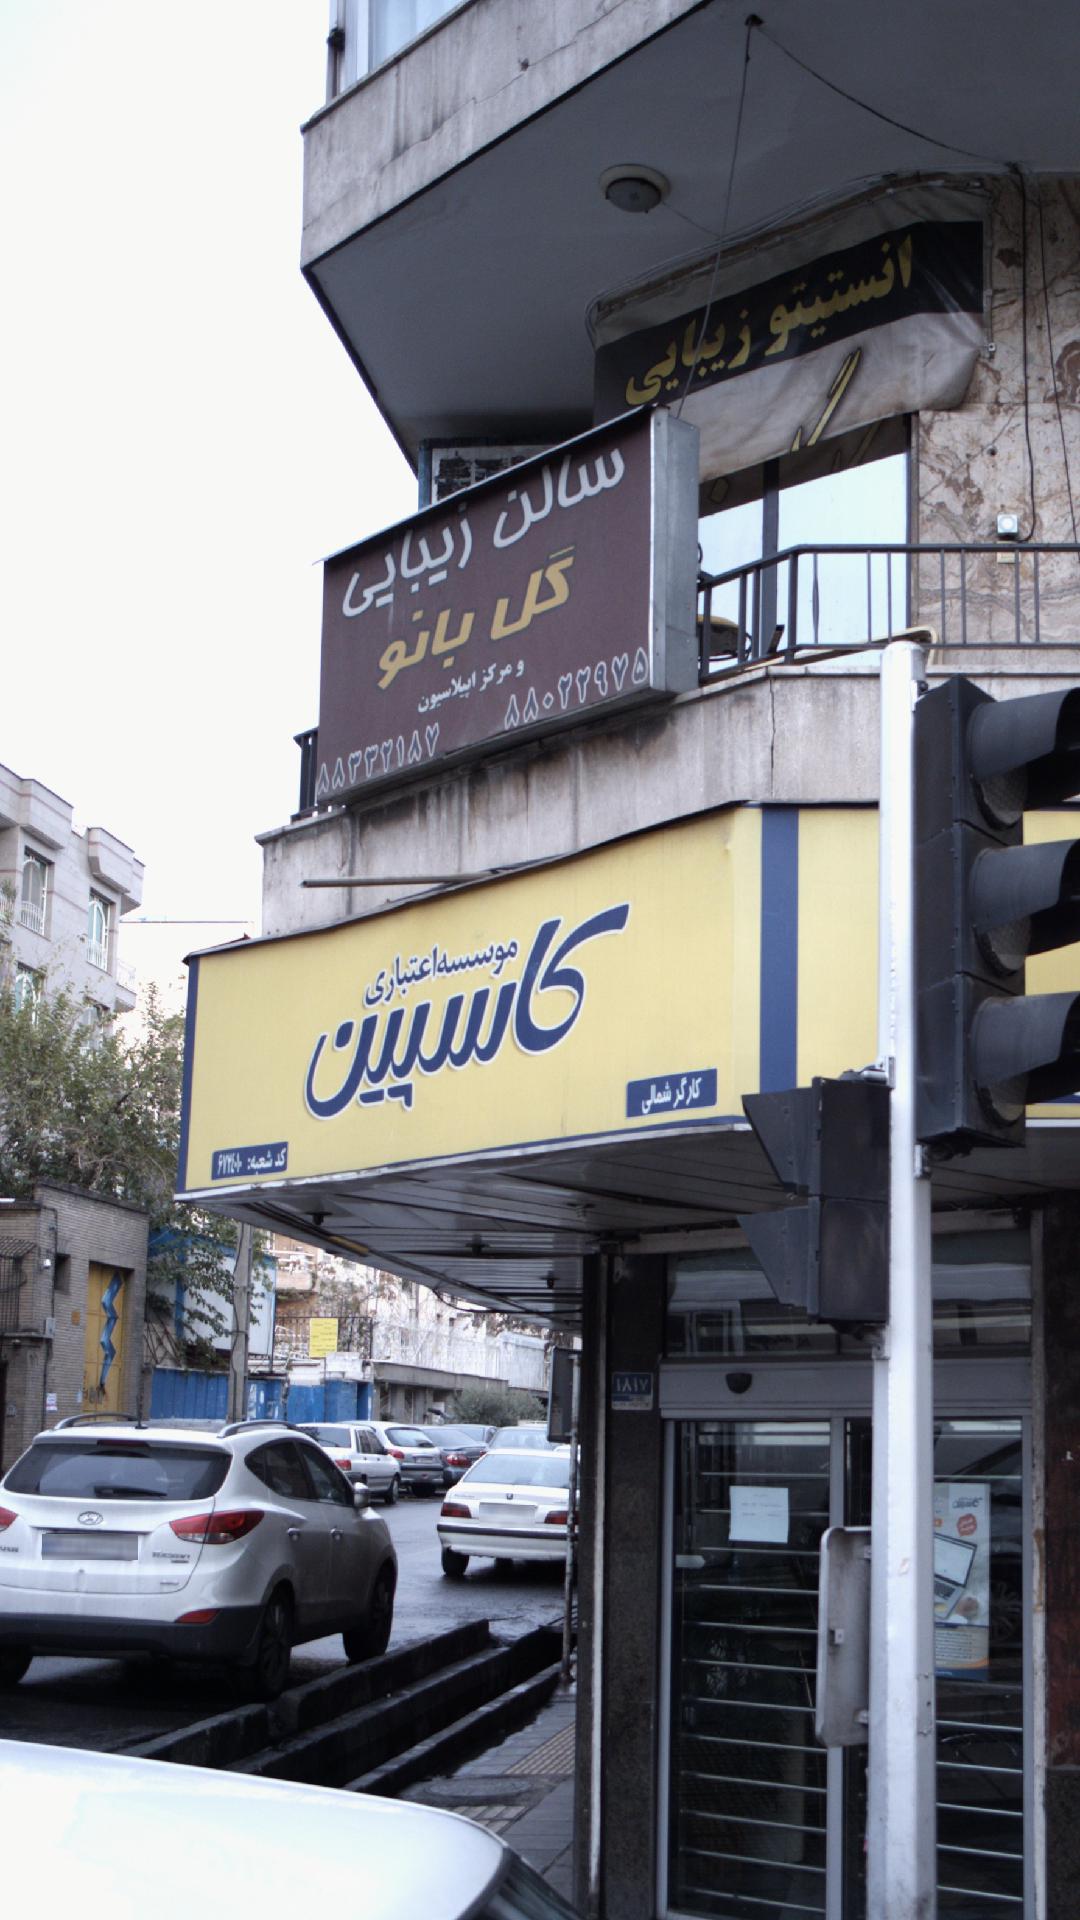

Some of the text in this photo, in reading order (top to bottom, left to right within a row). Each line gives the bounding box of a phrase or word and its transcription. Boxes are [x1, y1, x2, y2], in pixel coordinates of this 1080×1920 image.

[764, 234, 913, 356] انستیتو
[625, 307, 752, 405] زیبایی
[342, 448, 626, 618] سالن زیبایی
[376, 545, 576, 690] گل بانو
[417, 659, 525, 713] و مرکز اپیلاسیون
[504, 646, 649, 731] ۸۸۰۲۲۹۷۵
[317, 721, 440, 796] ۸۸۳۳۲۱۸۷
[304, 903, 631, 1119] کاسپین
[641, 1076, 703, 1114] کارگر شمالی
[274, 1147, 287, 1167] کد
[616, 1376, 649, 1392] ۱۸۱۷
